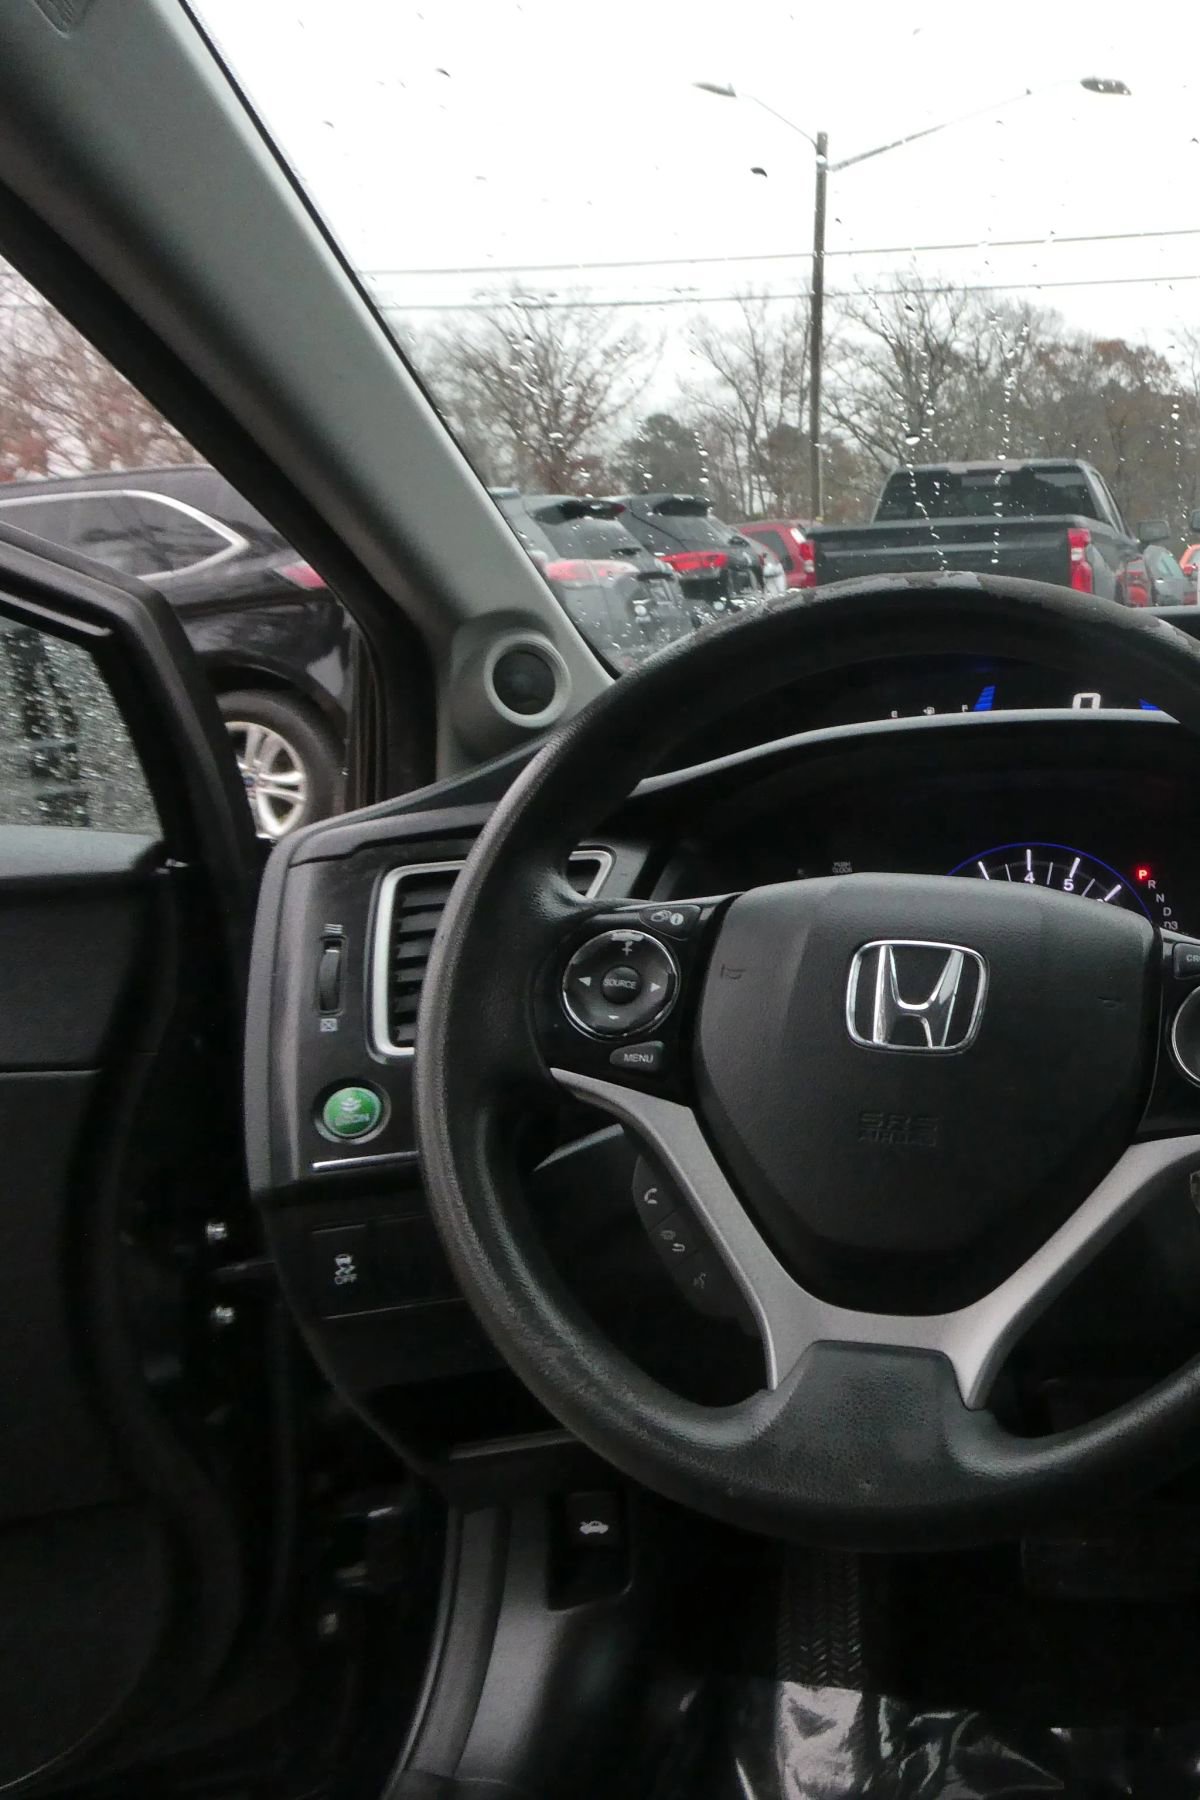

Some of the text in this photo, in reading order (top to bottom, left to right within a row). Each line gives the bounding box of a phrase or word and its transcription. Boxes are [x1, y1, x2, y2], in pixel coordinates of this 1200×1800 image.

[1023, 871, 1035, 884] 4
[1137, 869, 1148, 880] P
[1063, 878, 1075, 891] 5
[1147, 879, 1157, 889] R
[1155, 893, 1165, 903] N
[1162, 906, 1172, 917] D
[602, 977, 637, 990] SOURCE
[623, 1053, 654, 1063] MENU
